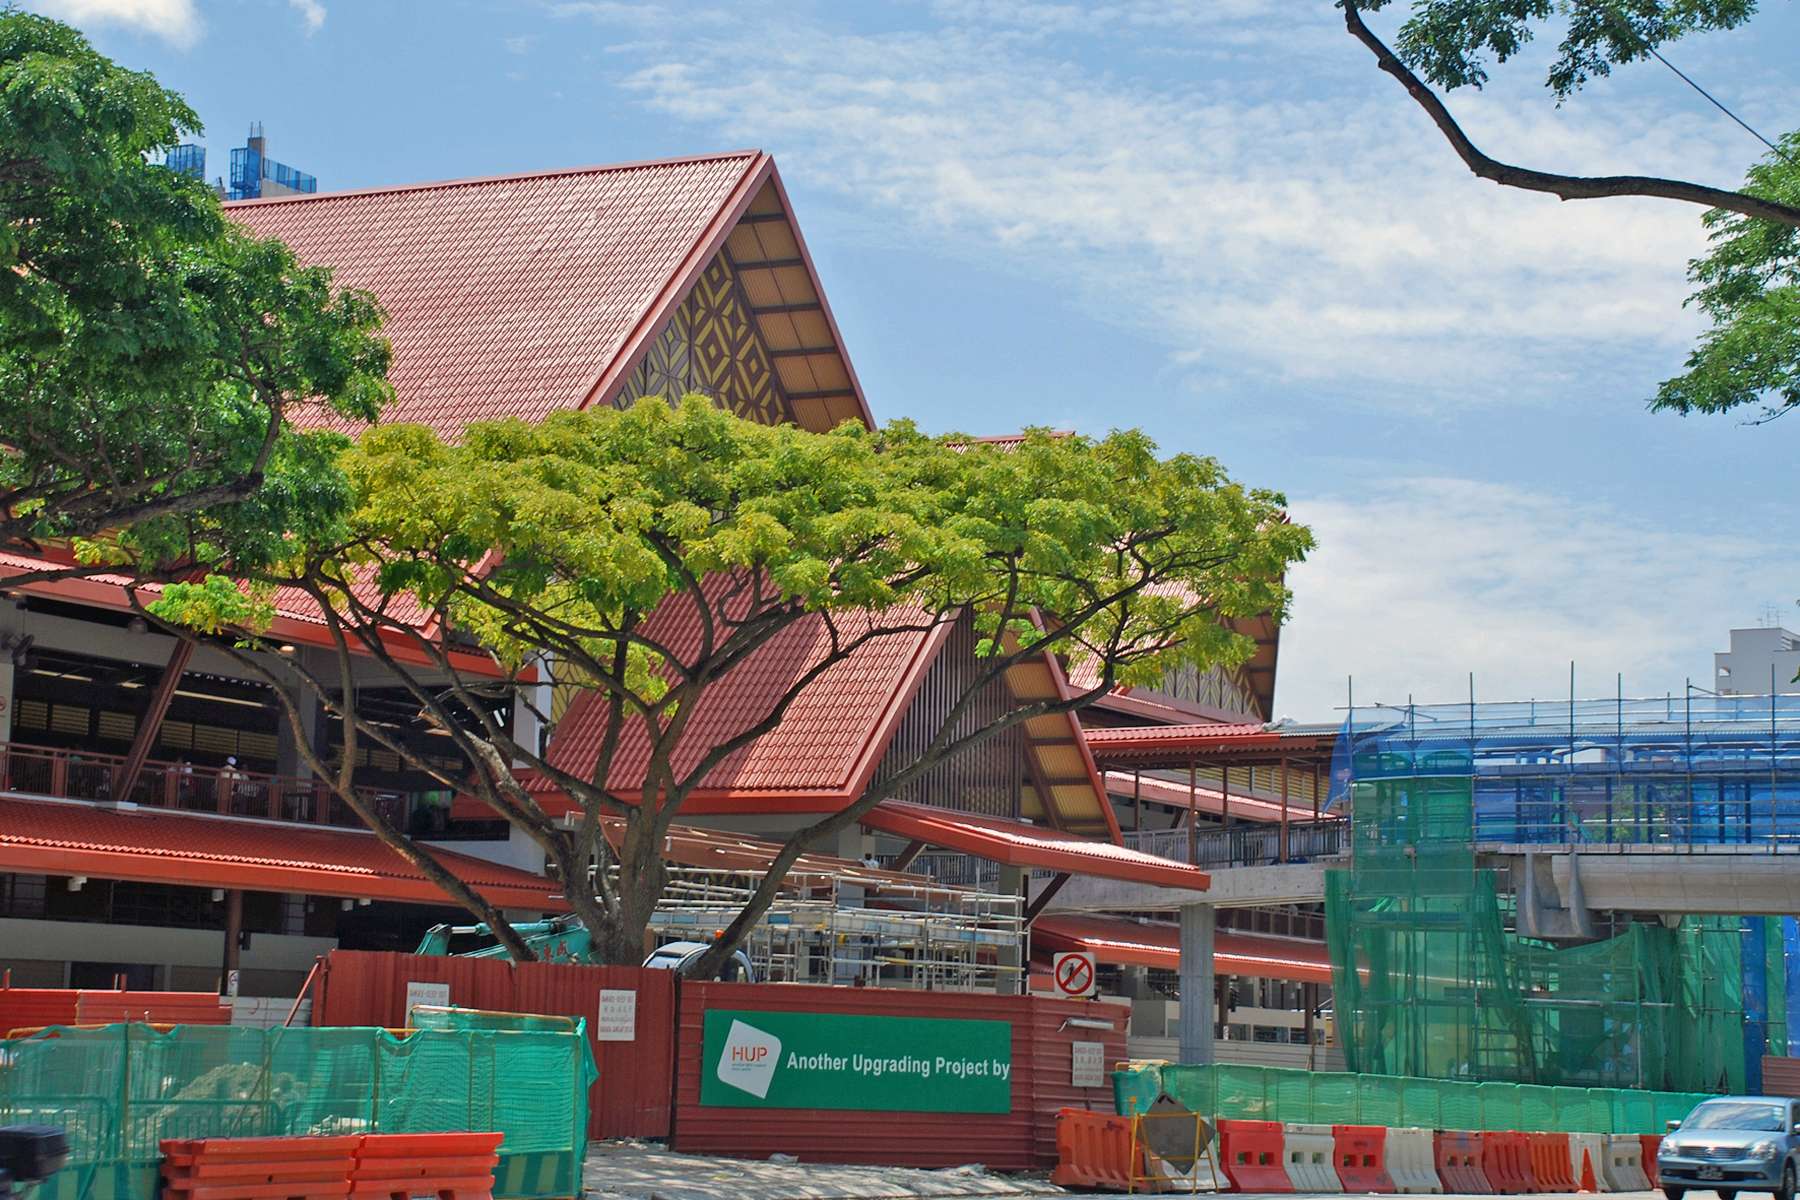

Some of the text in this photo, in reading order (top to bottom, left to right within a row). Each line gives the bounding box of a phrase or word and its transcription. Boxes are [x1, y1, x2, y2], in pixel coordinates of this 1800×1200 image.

[732, 1046, 768, 1061] HUP
[787, 1052, 1010, 1080] Another Upgrading Project by
